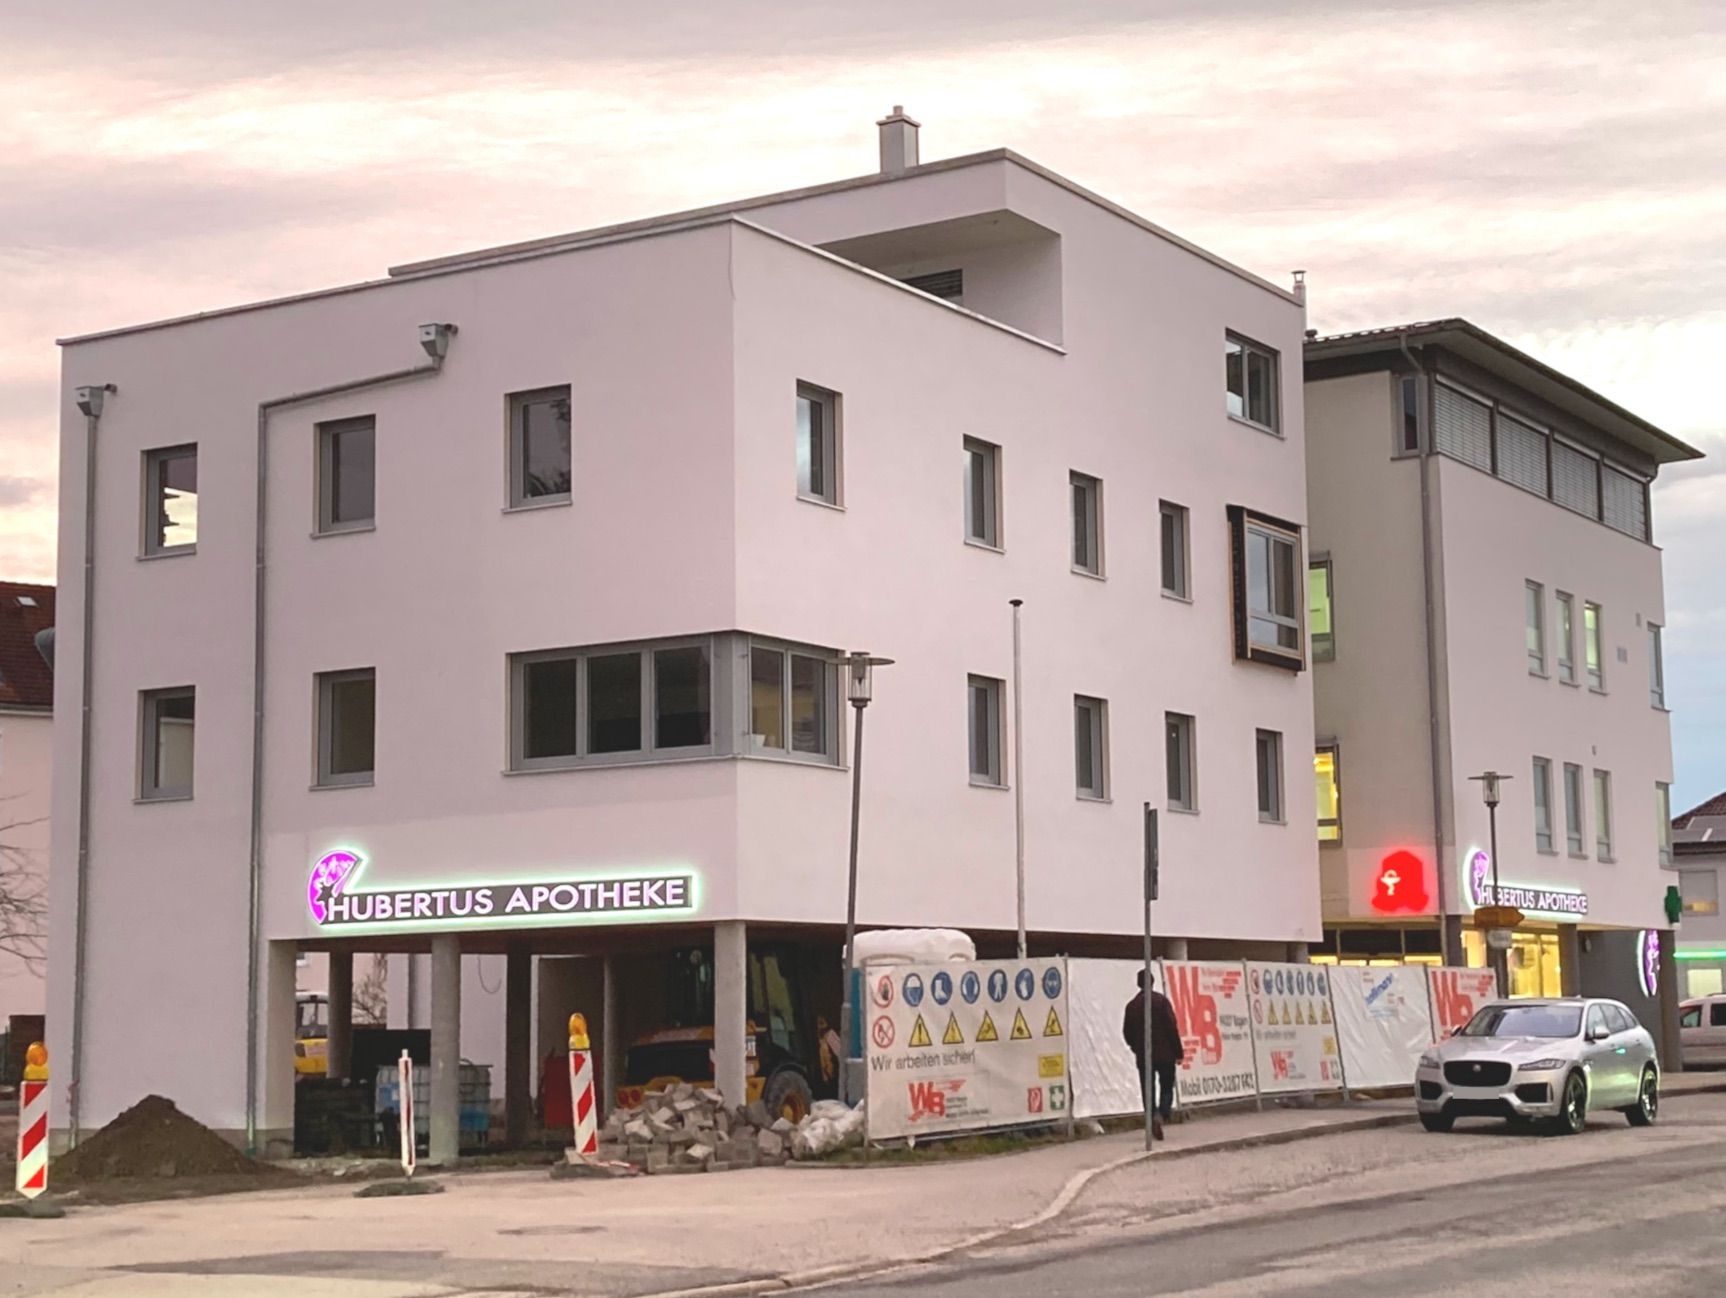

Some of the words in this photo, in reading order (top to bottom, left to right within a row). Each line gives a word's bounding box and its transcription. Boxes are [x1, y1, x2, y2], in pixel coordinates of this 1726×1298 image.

[327, 889, 493, 922] HUBERTUS
[504, 879, 685, 914] APOTHEKE
[1537, 893, 1588, 912] APOTHEKE
[871, 1056, 891, 1072] Wir
[895, 1052, 940, 1070] arbeiten
